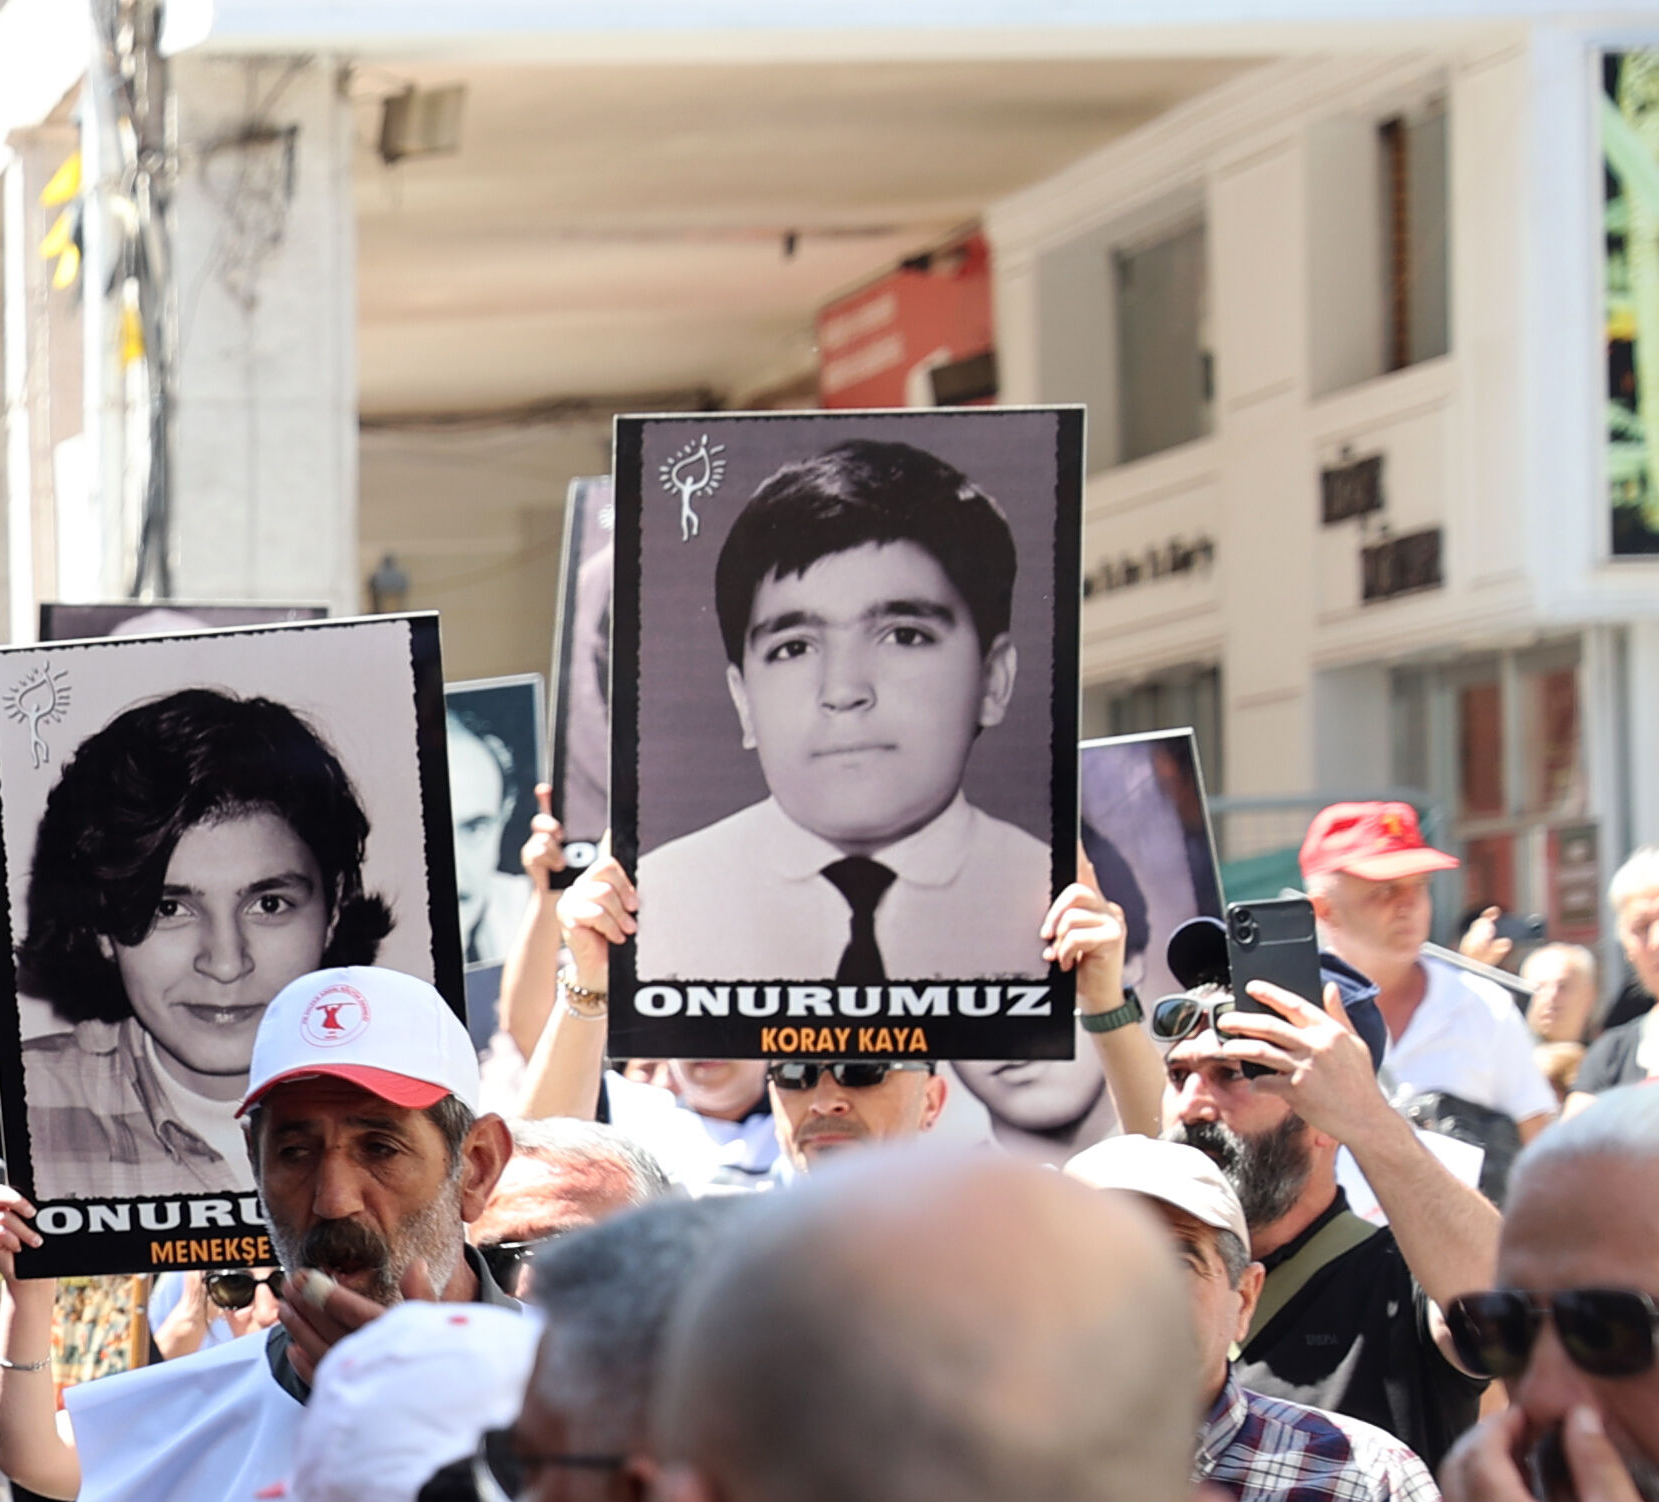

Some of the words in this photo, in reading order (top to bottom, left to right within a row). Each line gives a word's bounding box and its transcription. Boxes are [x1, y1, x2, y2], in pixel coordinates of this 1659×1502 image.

[633, 985, 1052, 1017] ONURUMUZ
[760, 1027, 853, 1053] KORAY
[858, 1027, 928, 1053] KAYA
[35, 1197, 268, 1235] ONURU
[150, 1235, 271, 1267] MENEKŞE
